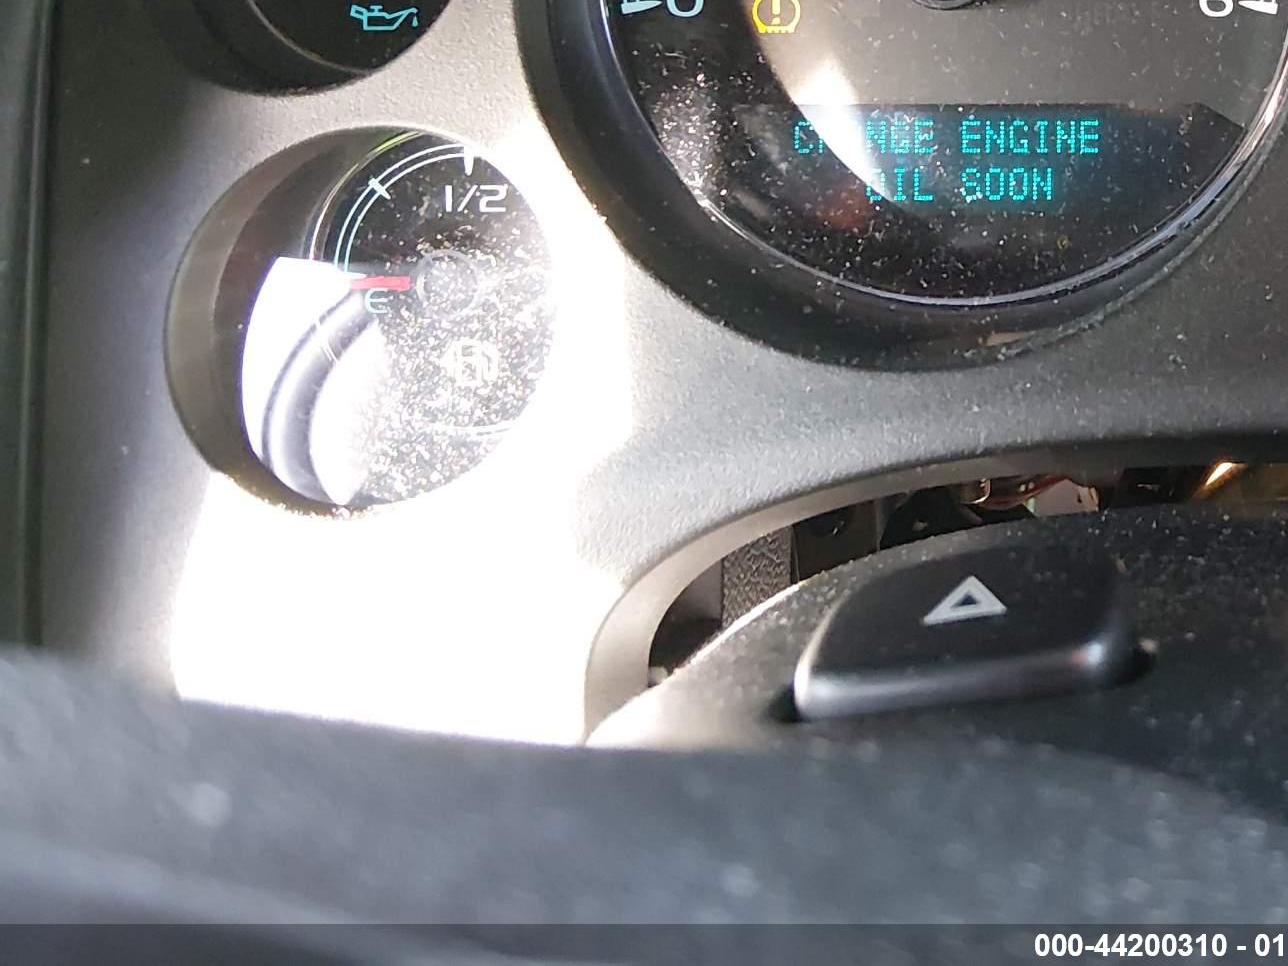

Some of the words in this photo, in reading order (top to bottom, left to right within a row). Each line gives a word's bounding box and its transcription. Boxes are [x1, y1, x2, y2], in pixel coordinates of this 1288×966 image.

[794, 121, 934, 153] CNGE
[961, 121, 1099, 153] ENGINE
[445, 185, 508, 212] 1/2
[962, 168, 1052, 201] SOON
